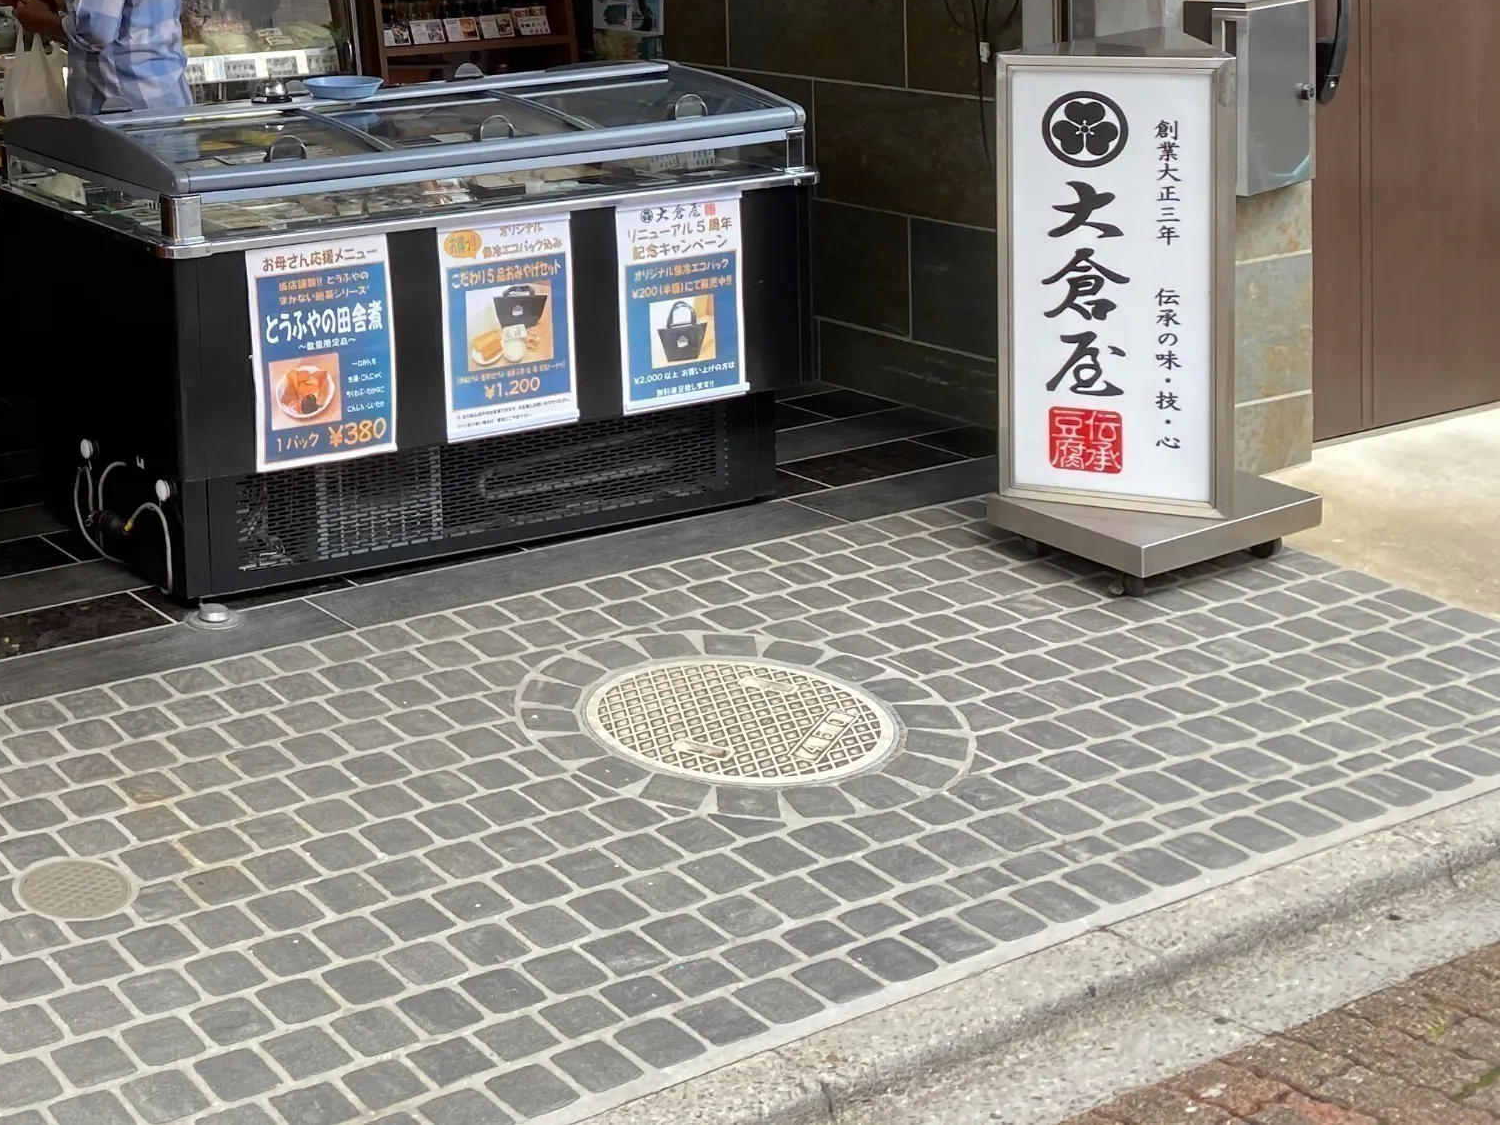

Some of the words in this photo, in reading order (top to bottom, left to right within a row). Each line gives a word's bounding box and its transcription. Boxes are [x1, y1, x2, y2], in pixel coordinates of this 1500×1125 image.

[1154, 119, 1182, 246] 創業大正三年
[499, 222, 543, 238] オリジナル
[656, 203, 701, 223] 大倉屋
[262, 248, 378, 273] お母さん応援メニュー
[632, 234, 728, 261] 記念キャンペーン
[326, 271, 370, 286] とうふやの
[1041, 180, 1130, 398] 大倉屋
[265, 299, 384, 345] とうふやの田舎煮
[1154, 287, 1182, 450] 伝承の味・技・心
[276, 431, 319, 453] 1パック
[328, 416, 387, 448] ¥380
[1051, 410, 1086, 472] 豆腐
[1085, 410, 1122, 472] 伝承
